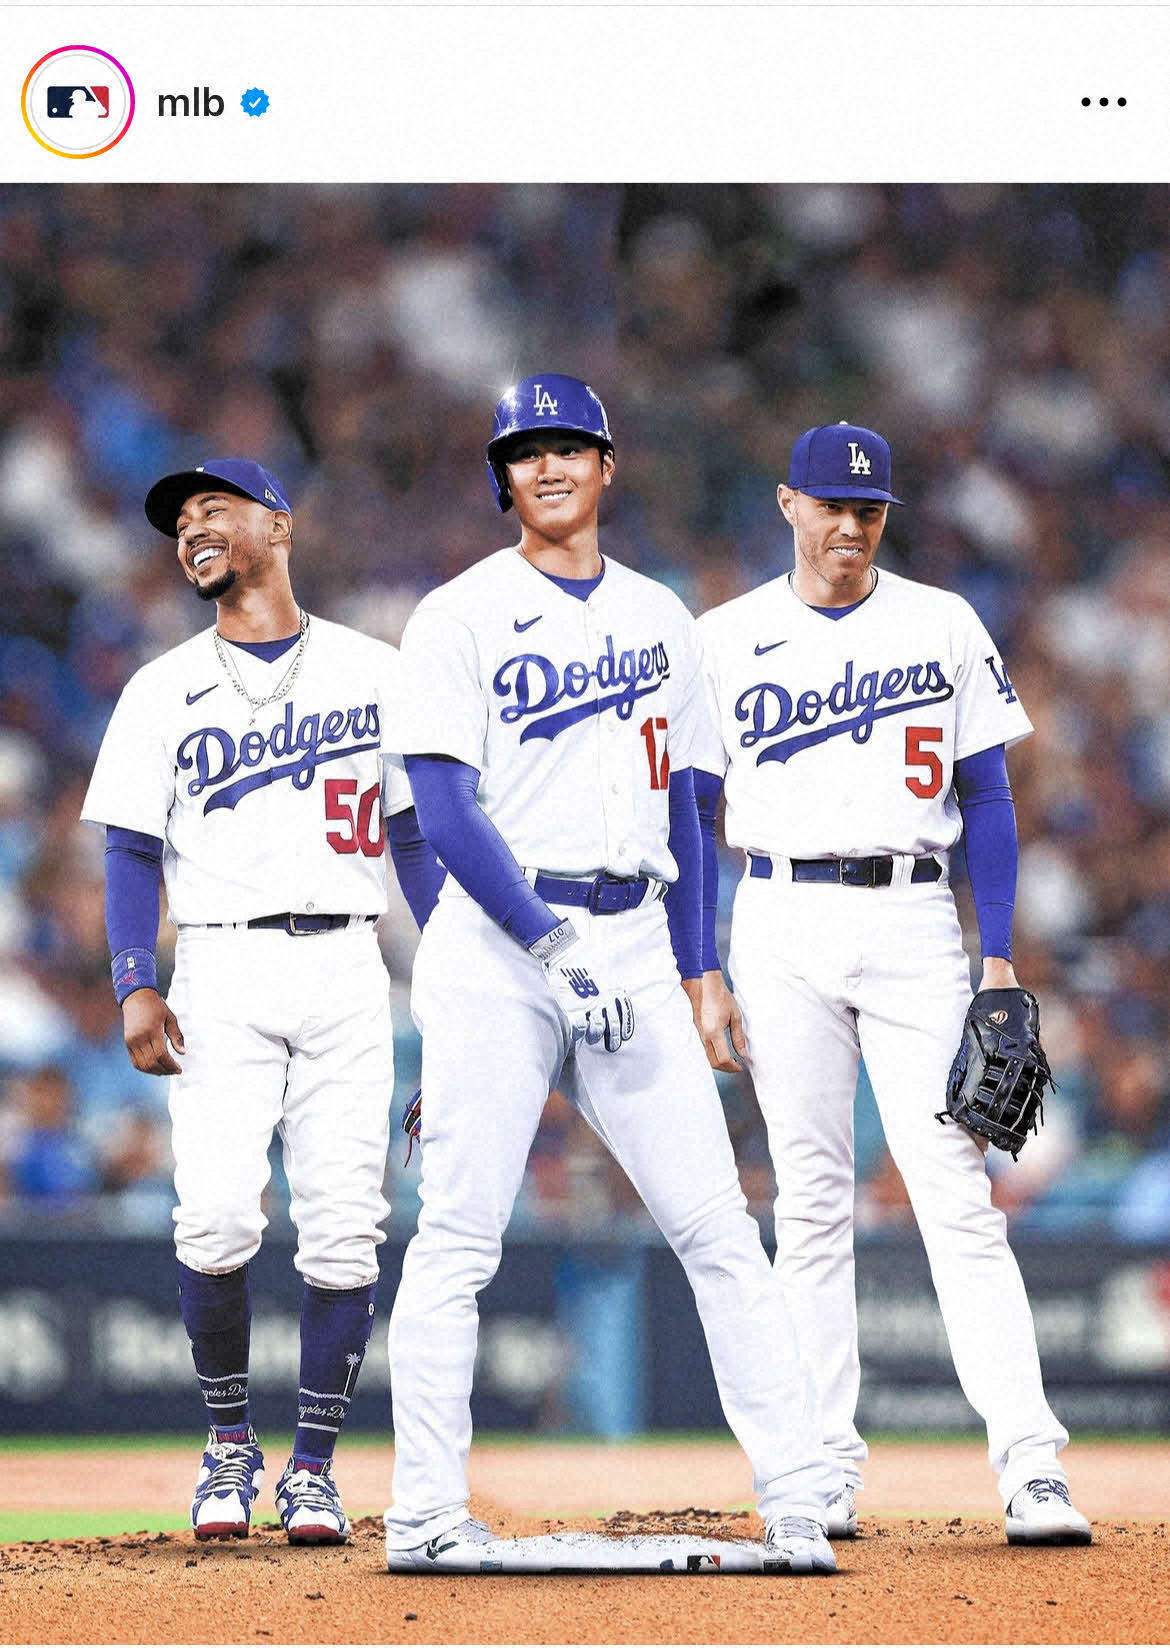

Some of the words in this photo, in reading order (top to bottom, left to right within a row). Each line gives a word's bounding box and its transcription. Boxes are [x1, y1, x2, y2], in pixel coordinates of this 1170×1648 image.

[533, 384, 558, 416] LA
[848, 442, 872, 476] LA
[493, 635, 670, 724] Dodgers
[735, 661, 954, 749] Dodgers
[177, 703, 381, 797] Dodgers
[640, 717, 670, 790] 17
[905, 726, 943, 799] 5
[324, 779, 384, 857] 50
